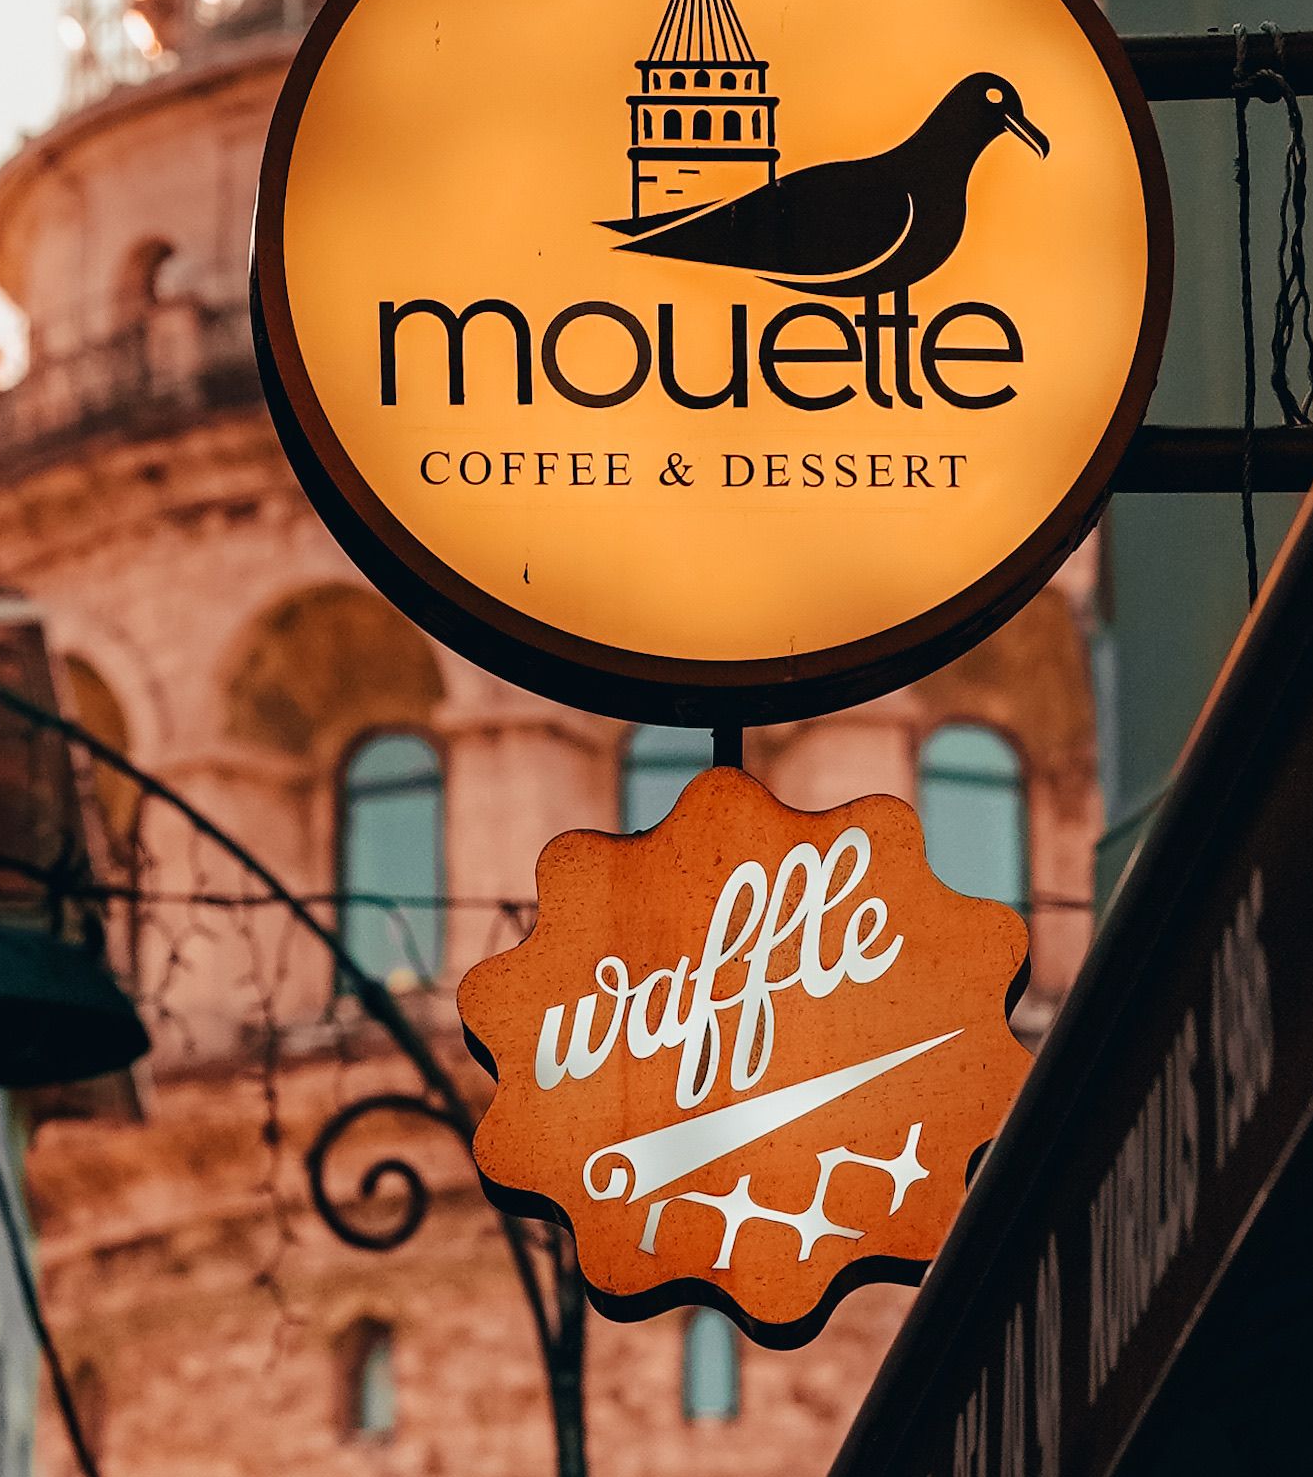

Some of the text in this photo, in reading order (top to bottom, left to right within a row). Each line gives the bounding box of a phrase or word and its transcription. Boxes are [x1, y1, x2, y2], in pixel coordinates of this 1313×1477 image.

[379, 291, 1023, 411] mouette
[420, 451, 970, 489] COFFEE & DESSERT
[534, 827, 904, 1109] waffle
